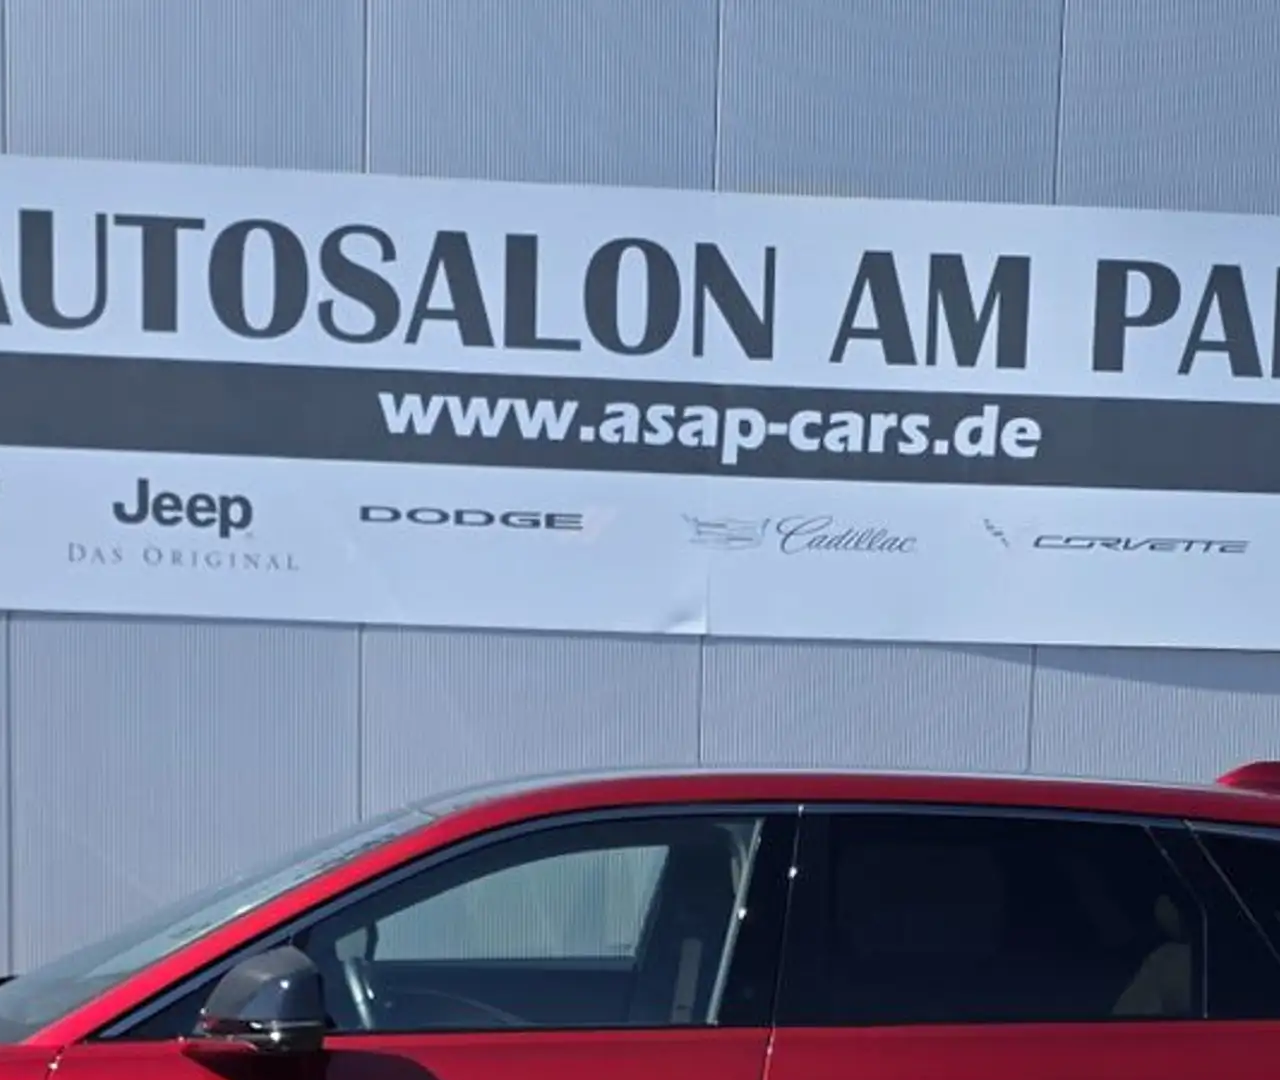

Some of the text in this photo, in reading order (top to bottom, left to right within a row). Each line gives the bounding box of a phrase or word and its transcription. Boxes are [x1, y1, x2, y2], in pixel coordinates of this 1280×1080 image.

[829, 249, 1032, 369] AM
[378, 391, 1043, 465] www.asap-cars.de
[112, 477, 254, 538] Jeep
[358, 505, 584, 530] DODGE
[775, 515, 919, 555] Cadillac
[1032, 535, 1250, 554] CORVETTE
[142, 545, 300, 571] ORIGINAL
